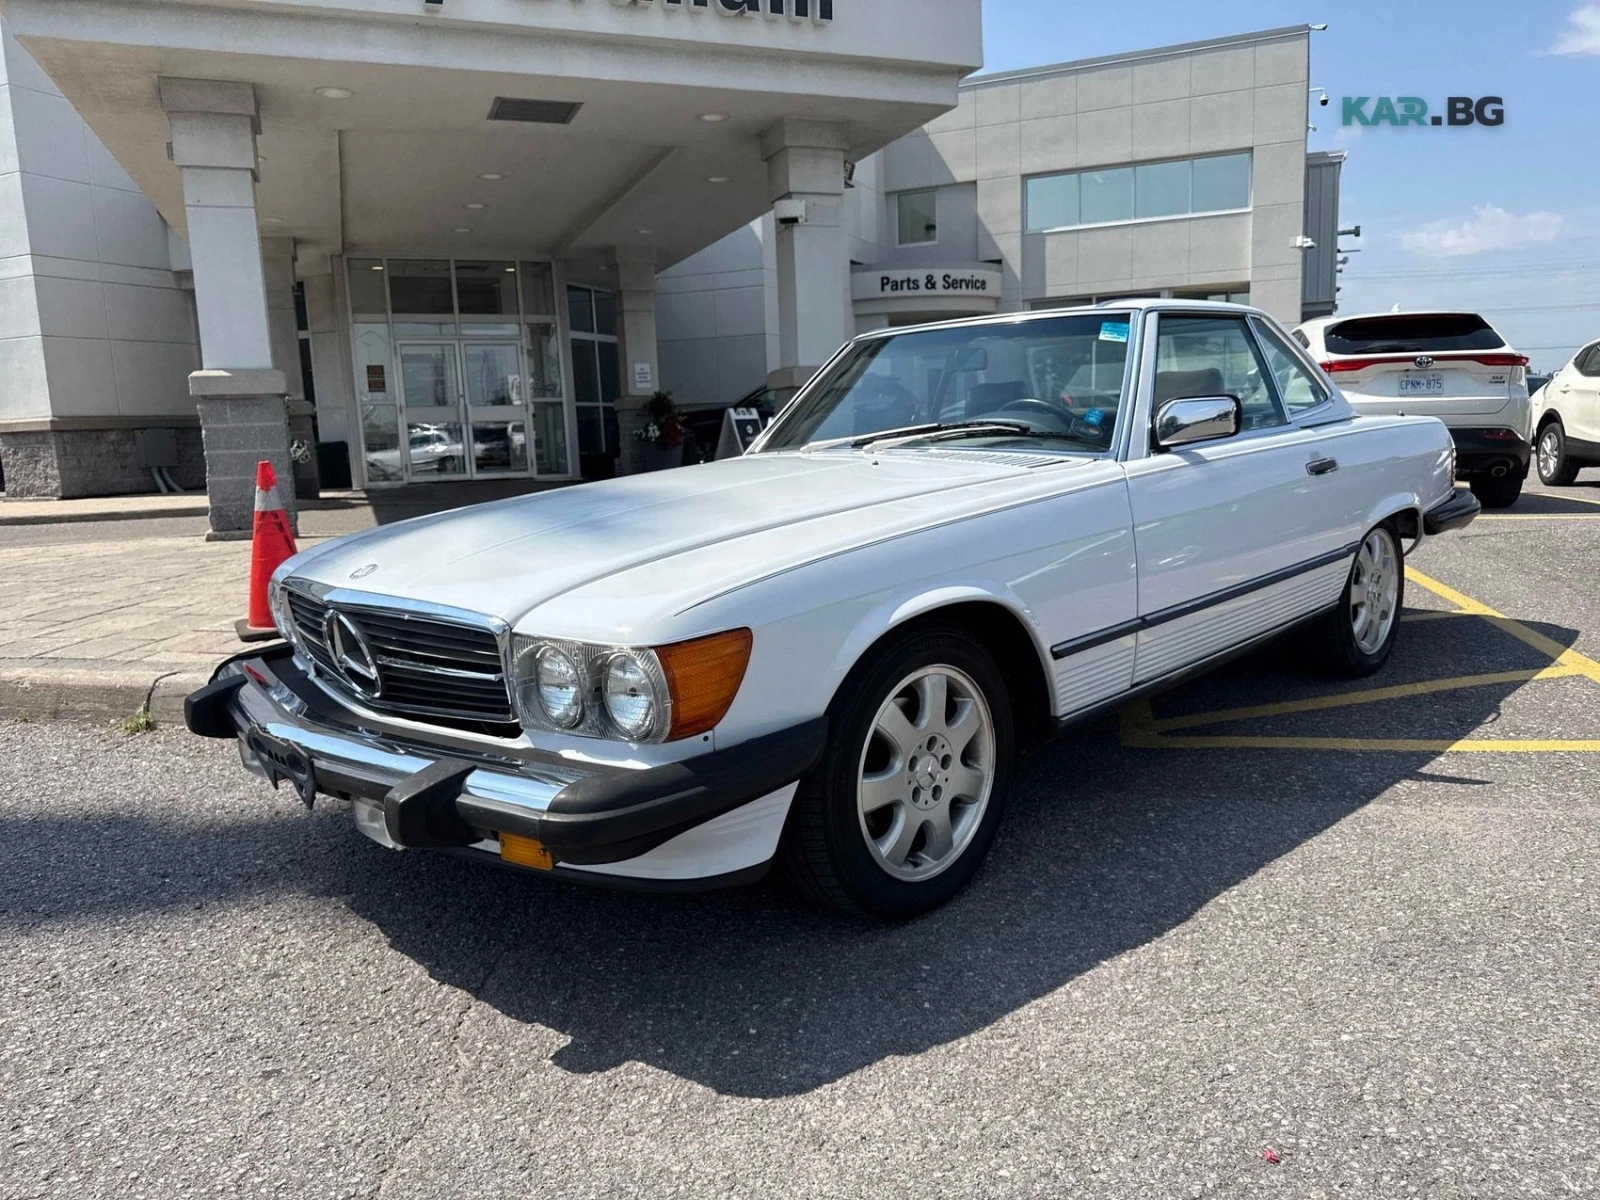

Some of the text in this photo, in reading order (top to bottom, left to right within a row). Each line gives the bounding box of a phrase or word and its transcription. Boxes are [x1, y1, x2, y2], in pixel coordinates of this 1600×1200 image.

[880, 274, 987, 292] Parts & Service
